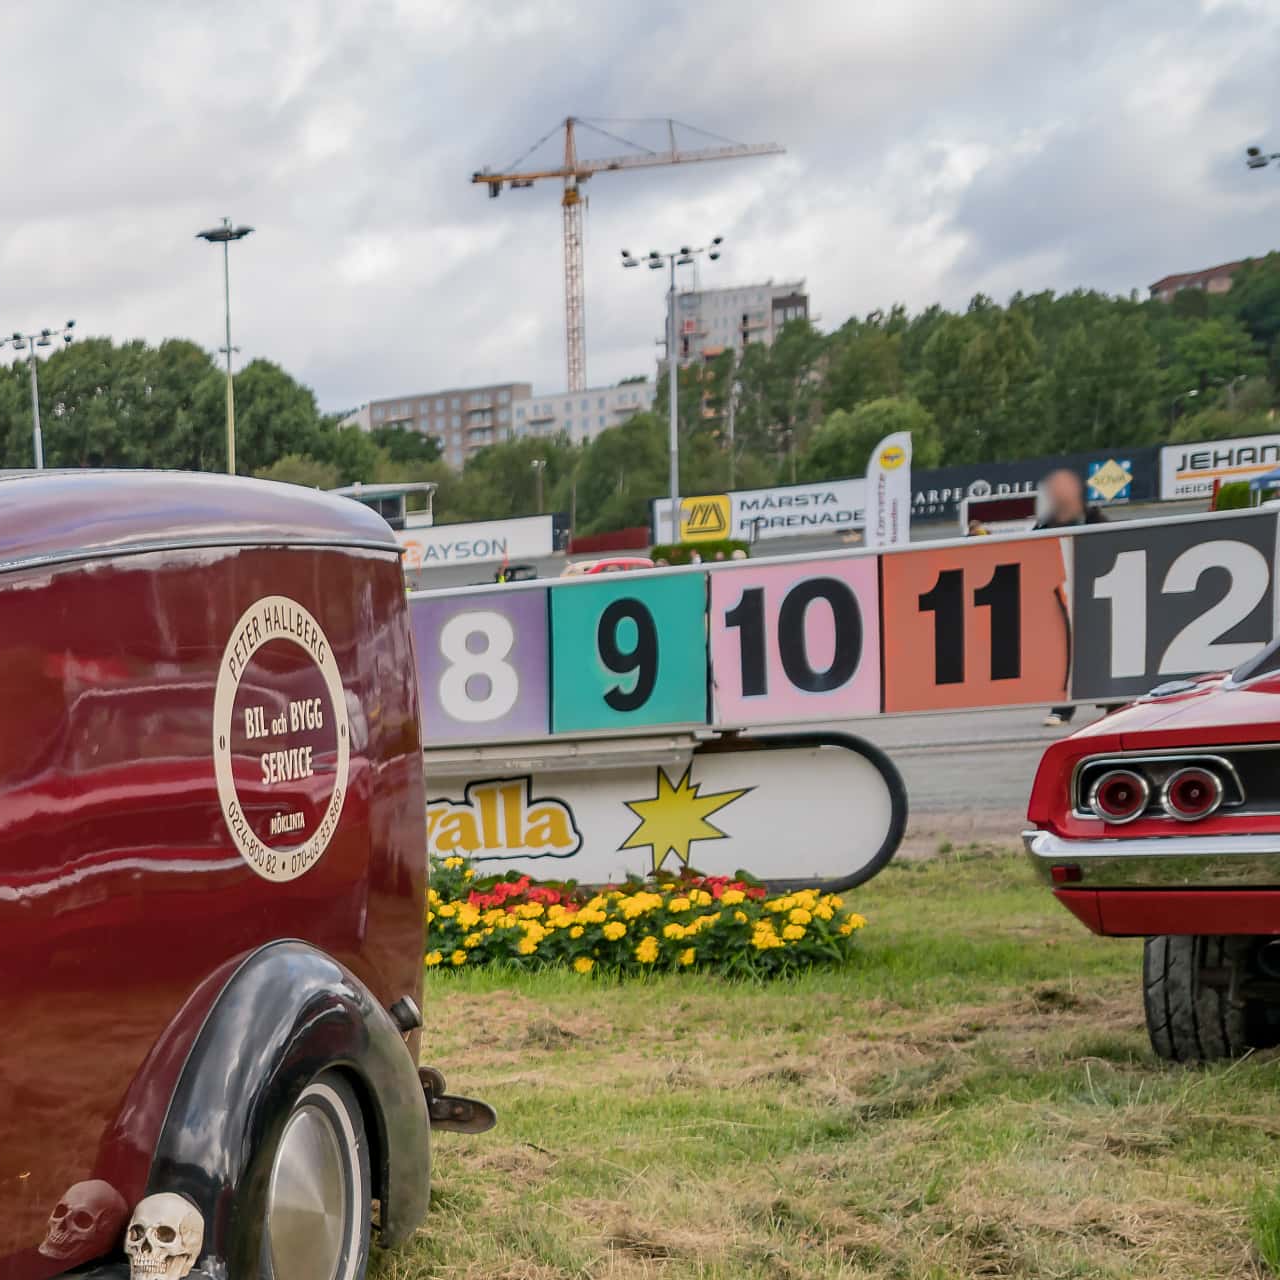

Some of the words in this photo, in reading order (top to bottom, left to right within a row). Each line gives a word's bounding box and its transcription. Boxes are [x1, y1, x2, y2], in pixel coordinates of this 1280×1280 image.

[912, 487, 963, 505] ARPE
[228, 615, 262, 682] PETER
[263, 604, 326, 665] HALLBERG
[439, 611, 519, 723] 8
[597, 597, 659, 713] 9
[725, 577, 862, 698] 10
[918, 562, 1021, 686] 11
[1093, 540, 1269, 678] 12
[244, 706, 269, 739] BIL
[272, 712, 288, 736] och
[289, 698, 323, 732] BYGG
[261, 746, 314, 785] SERVICE
[228, 801, 265, 867] 0224-800
[266, 854, 277, 874] 82
[270, 811, 305, 836] MÖKLINTA
